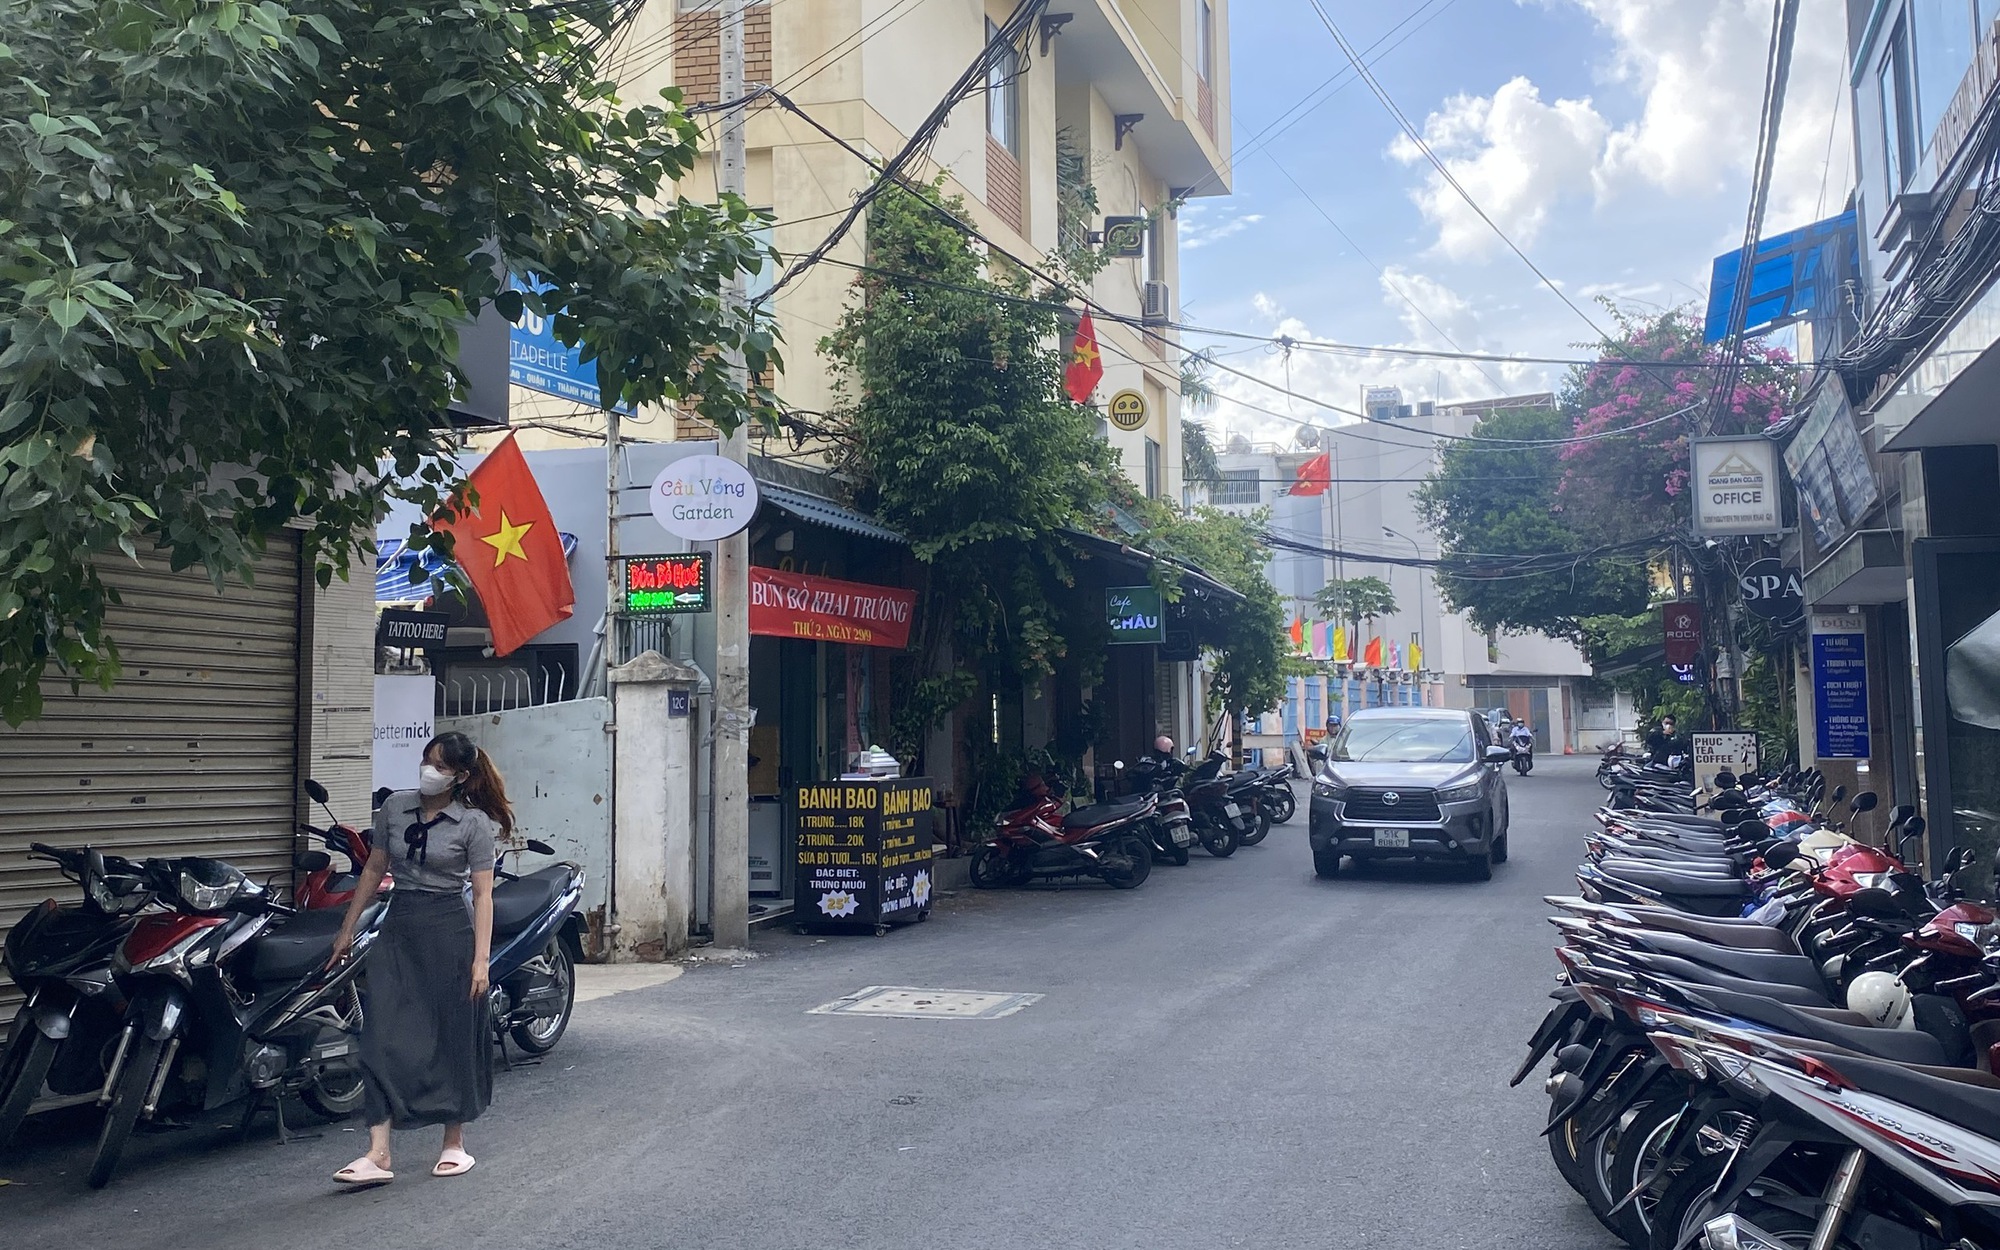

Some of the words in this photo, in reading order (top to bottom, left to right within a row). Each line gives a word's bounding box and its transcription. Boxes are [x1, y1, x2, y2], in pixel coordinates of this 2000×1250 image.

[557, 382, 579, 397] THÀNH
[580, 386, 593, 401] PHỐ
[661, 478, 694, 497] Cầu
[699, 477, 745, 498] Vồng
[1713, 491, 1761, 504] OFFICE
[672, 503, 733, 521] Garden
[1741, 574, 1804, 600] SPA
[752, 576, 783, 608] BÚN
[787, 581, 810, 611] BÒ
[811, 590, 849, 616] KHAI
[853, 596, 909, 623] TRƯƠNG
[1110, 595, 1131, 614] Cafe
[388, 621, 421, 638] TATTOO
[422, 624, 444, 639] HERE
[793, 619, 814, 635] THỨ
[826, 622, 851, 639] NGÀY
[1110, 613, 1158, 630] CHÂU
[1667, 630, 1700, 638] ROCK
[672, 697, 685, 709] 12C
[373, 722, 430, 740] betternick
[1695, 737, 1723, 746] PHUC
[1696, 755, 1733, 763] COFFEE
[799, 785, 841, 809] BÁNH
[846, 788, 877, 809] BAO
[883, 784, 909, 816] BÁNH
[912, 787, 931, 811] BAO
[800, 816, 804, 828] 1
[848, 816, 865, 828] 18K
[799, 835, 804, 846] 2
[861, 853, 878, 865] 15K
